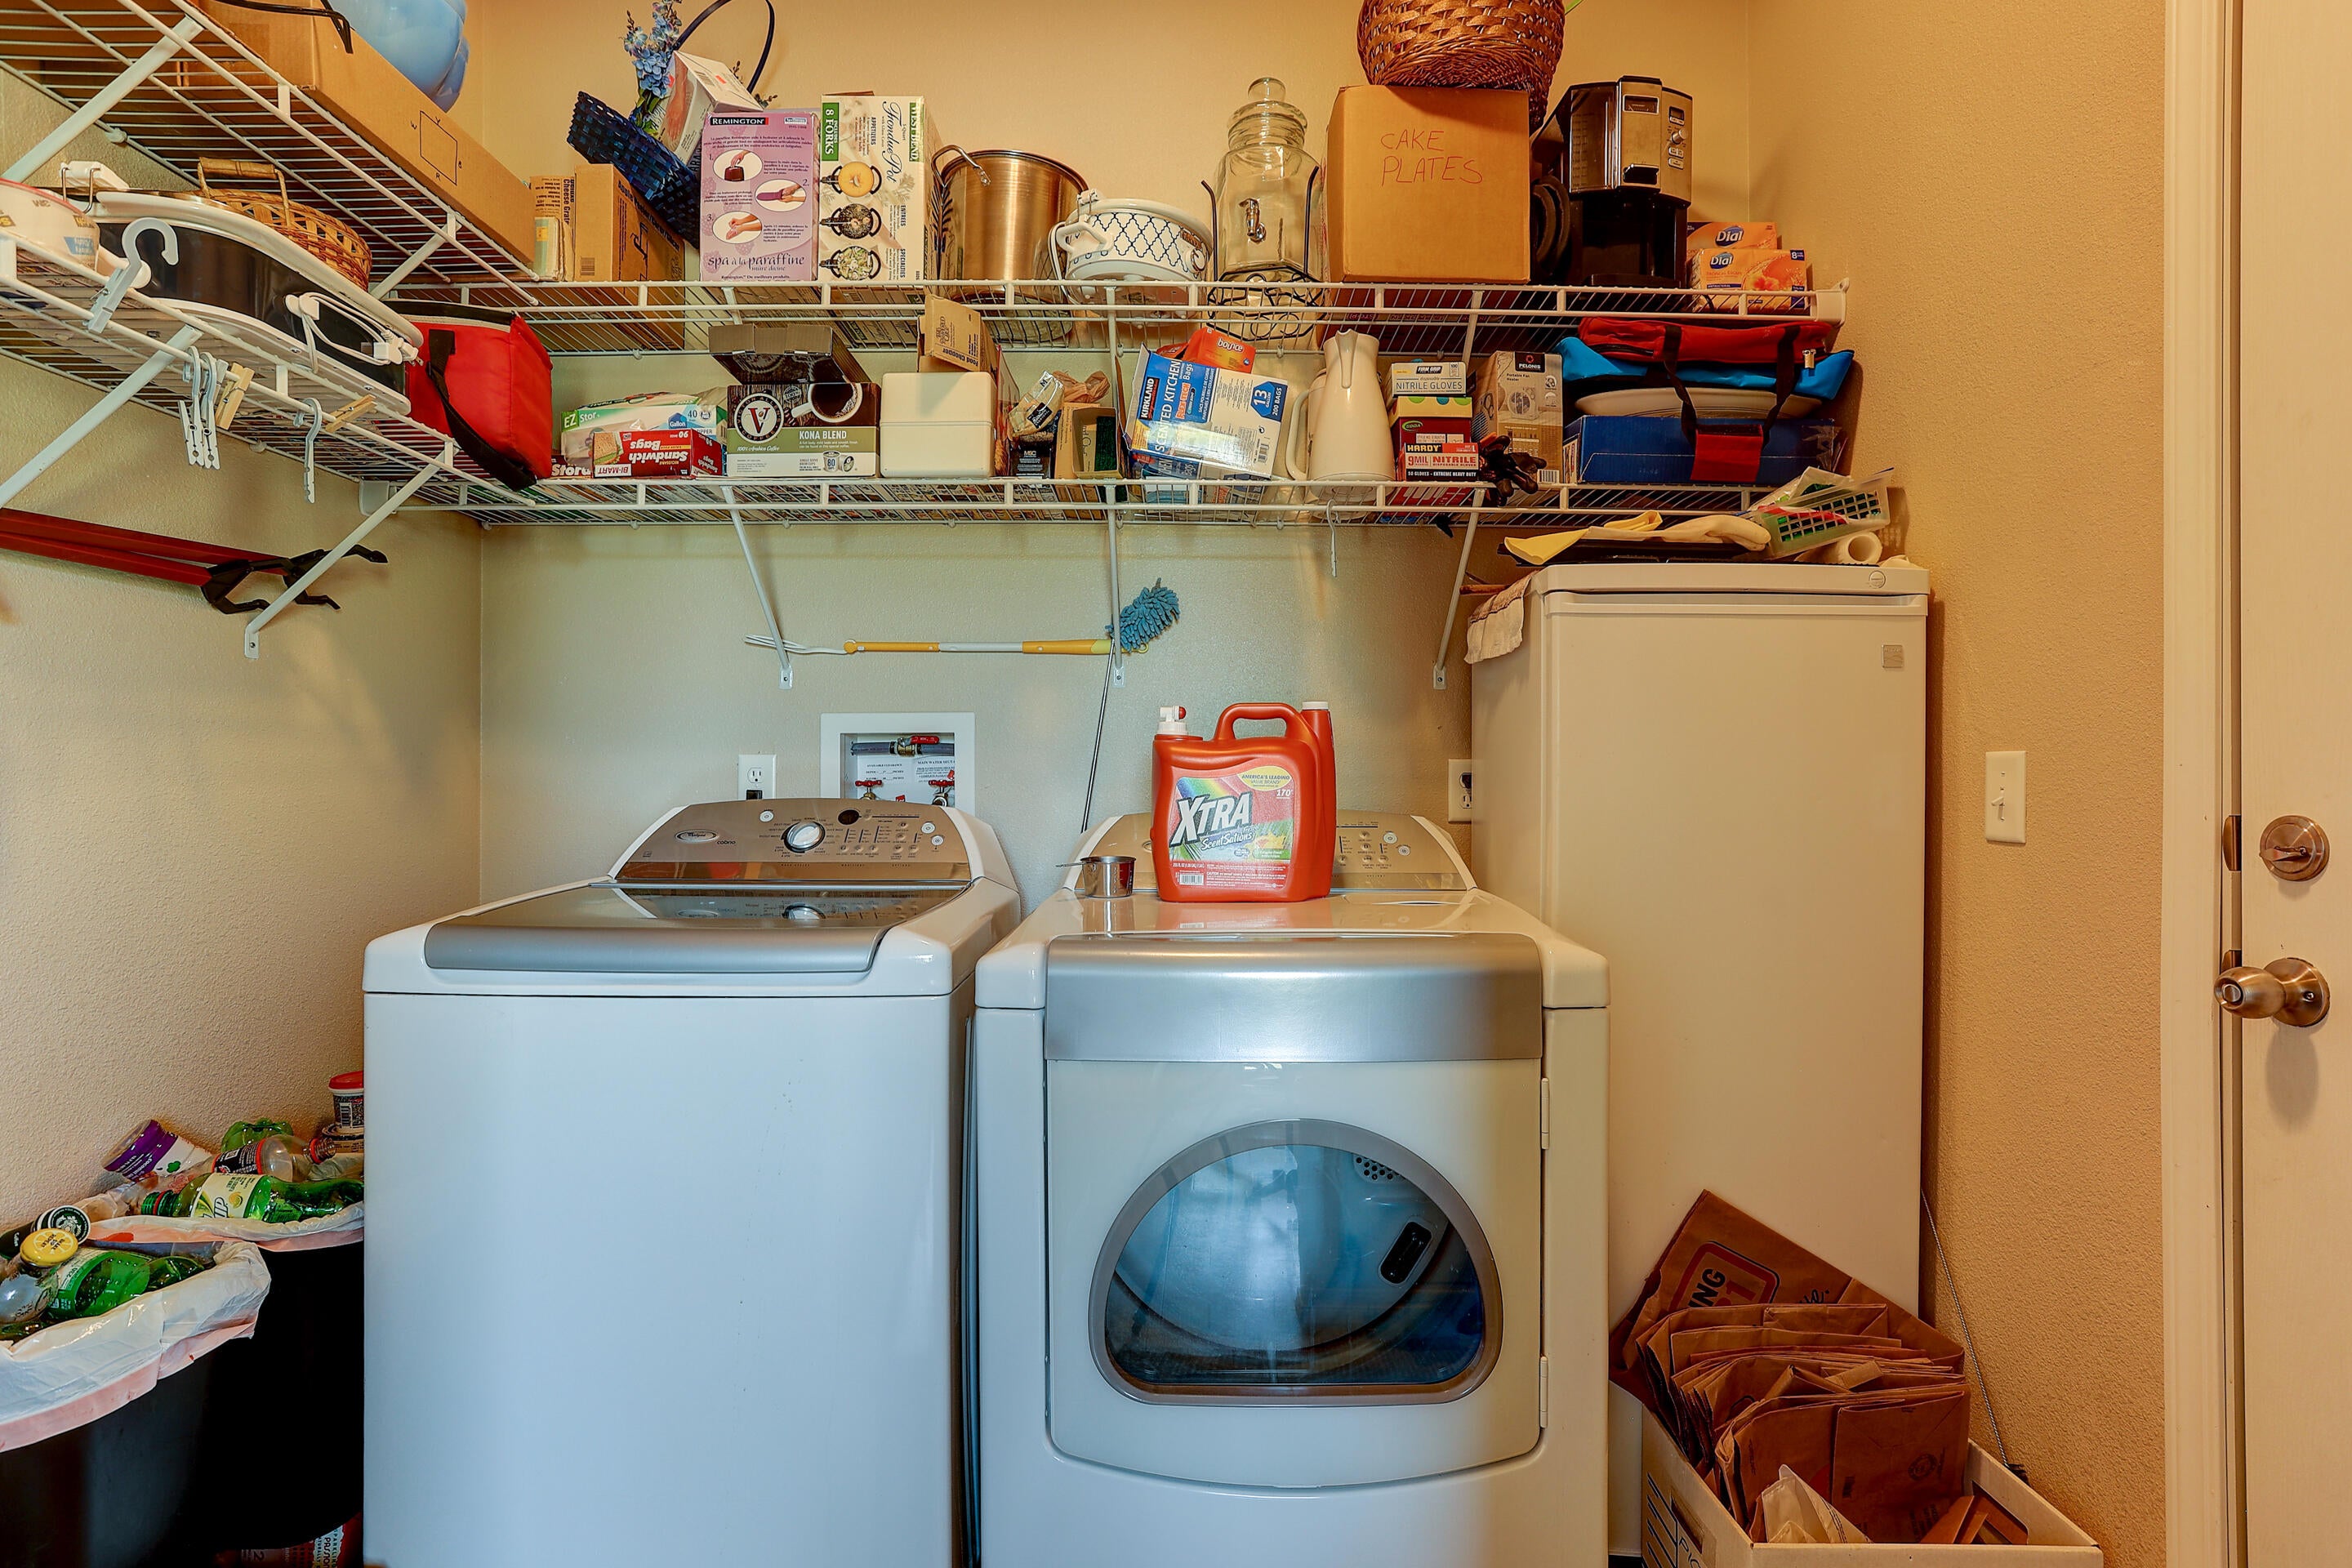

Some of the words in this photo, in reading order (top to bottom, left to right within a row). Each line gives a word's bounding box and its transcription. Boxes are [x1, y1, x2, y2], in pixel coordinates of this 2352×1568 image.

[825, 118, 834, 155] FORKS
[1380, 128, 1445, 151] CAKE
[882, 150, 902, 183] Pot
[1382, 155, 1483, 187] PLATES
[1716, 229, 1743, 243] Dial
[708, 256, 729, 270] spa
[748, 252, 804, 270] paraffine
[1710, 254, 1734, 266] Dial
[1791, 252, 1797, 260] 8
[1218, 338, 1244, 352] bounce
[1183, 363, 1194, 381] Bags
[1430, 381, 1463, 390] GLOVES
[1141, 378, 1155, 418] KIRKLAND
[1254, 389, 1267, 406] 13
[688, 410, 697, 418] 40
[1155, 403, 1172, 452] SCENTED
[1164, 361, 1182, 402] KITCHEN
[564, 413, 577, 429] EZ
[747, 408, 771, 434] V
[678, 430, 688, 439] 90
[799, 430, 821, 439] KONA
[822, 430, 847, 439] BLEND
[630, 440, 662, 451] Bags
[628, 451, 688, 464] Sandwich
[827, 458, 835, 467] 80
[1169, 792, 1251, 846] XTRA
[1200, 832, 1253, 851] ScentSations
